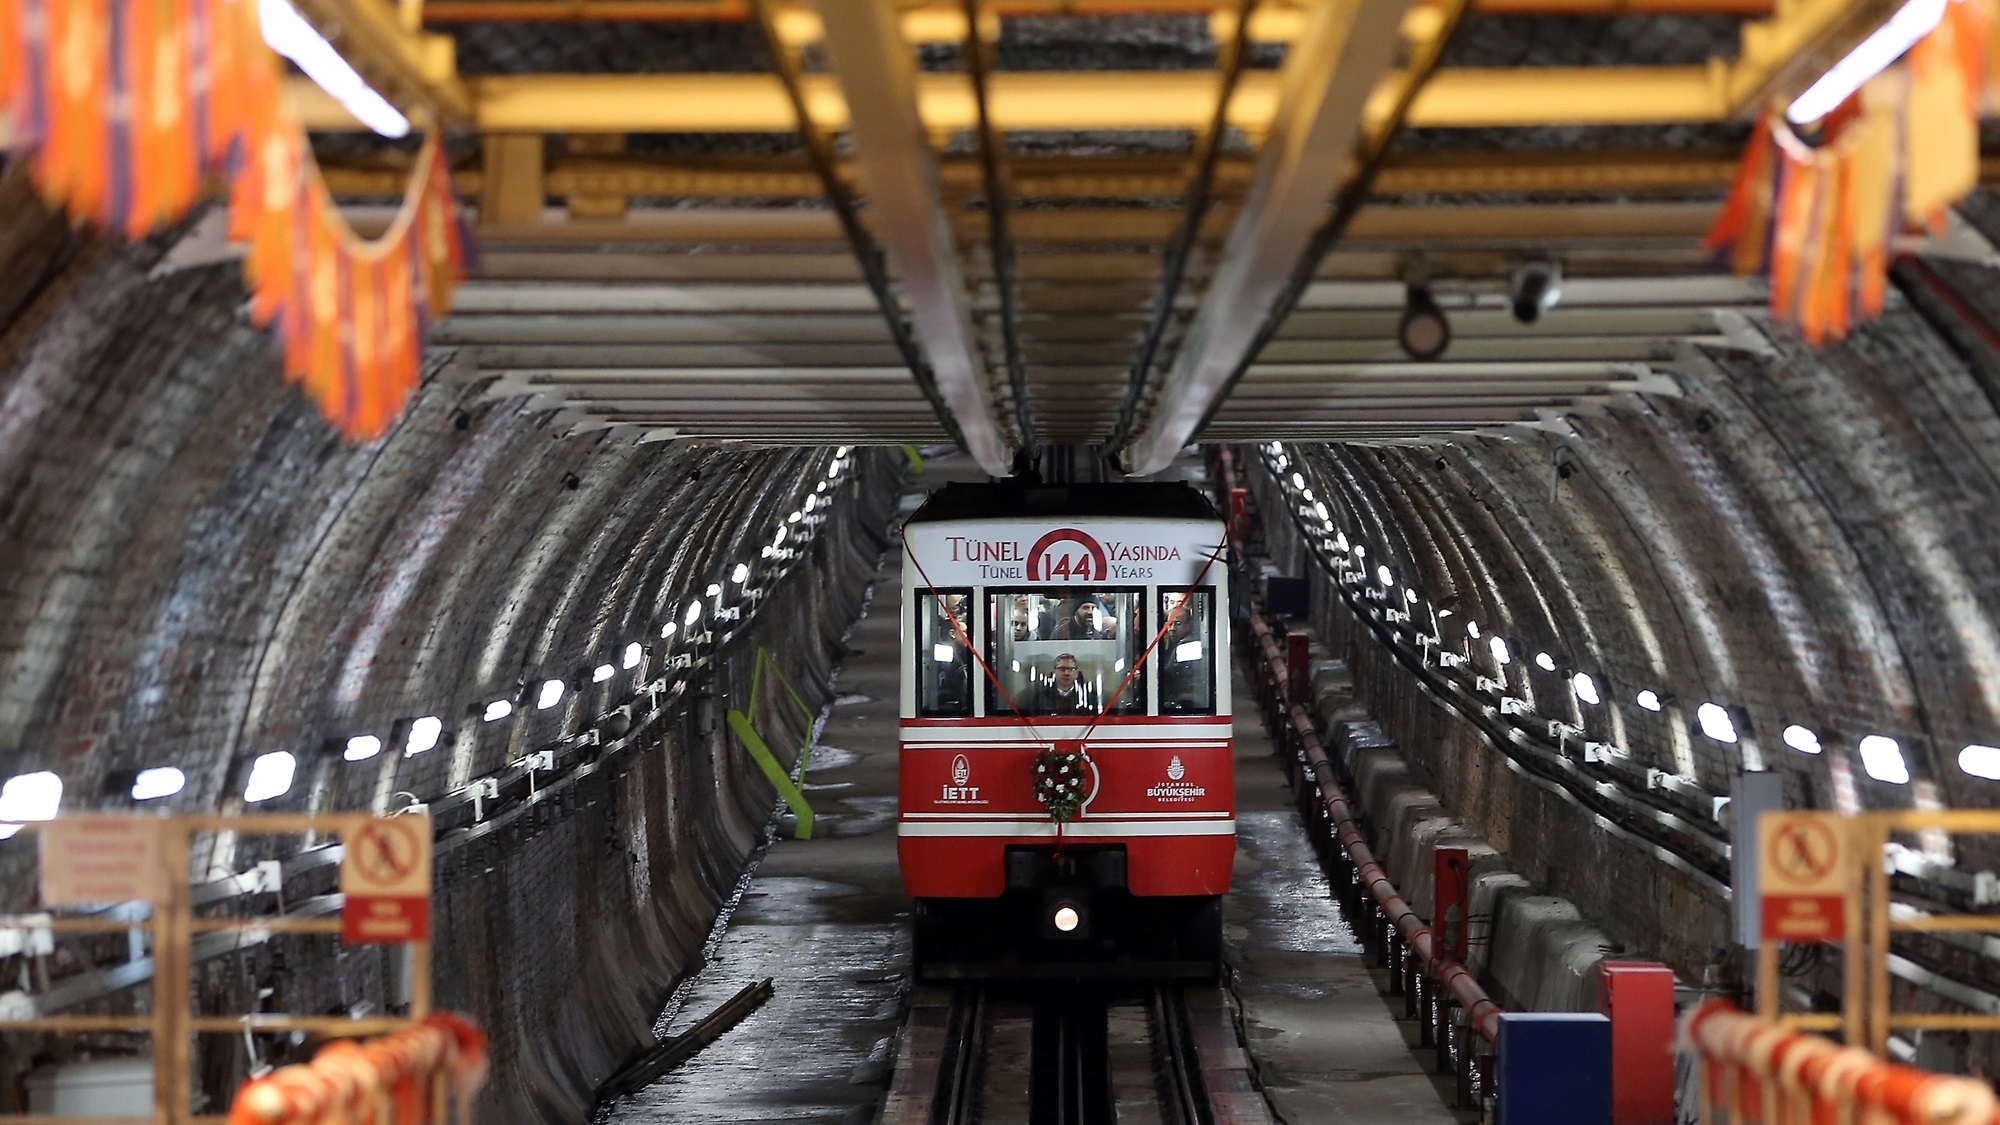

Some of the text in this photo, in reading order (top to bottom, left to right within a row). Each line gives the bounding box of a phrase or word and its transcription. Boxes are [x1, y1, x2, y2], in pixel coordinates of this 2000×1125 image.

[945, 536, 1181, 581] TÜNEL 144 YAŞINDA
[979, 564, 1153, 579] TÜNEL YEARS
[942, 784, 979, 800] İETT
[1146, 786, 1205, 798] BÜYÜKŞEHİR
